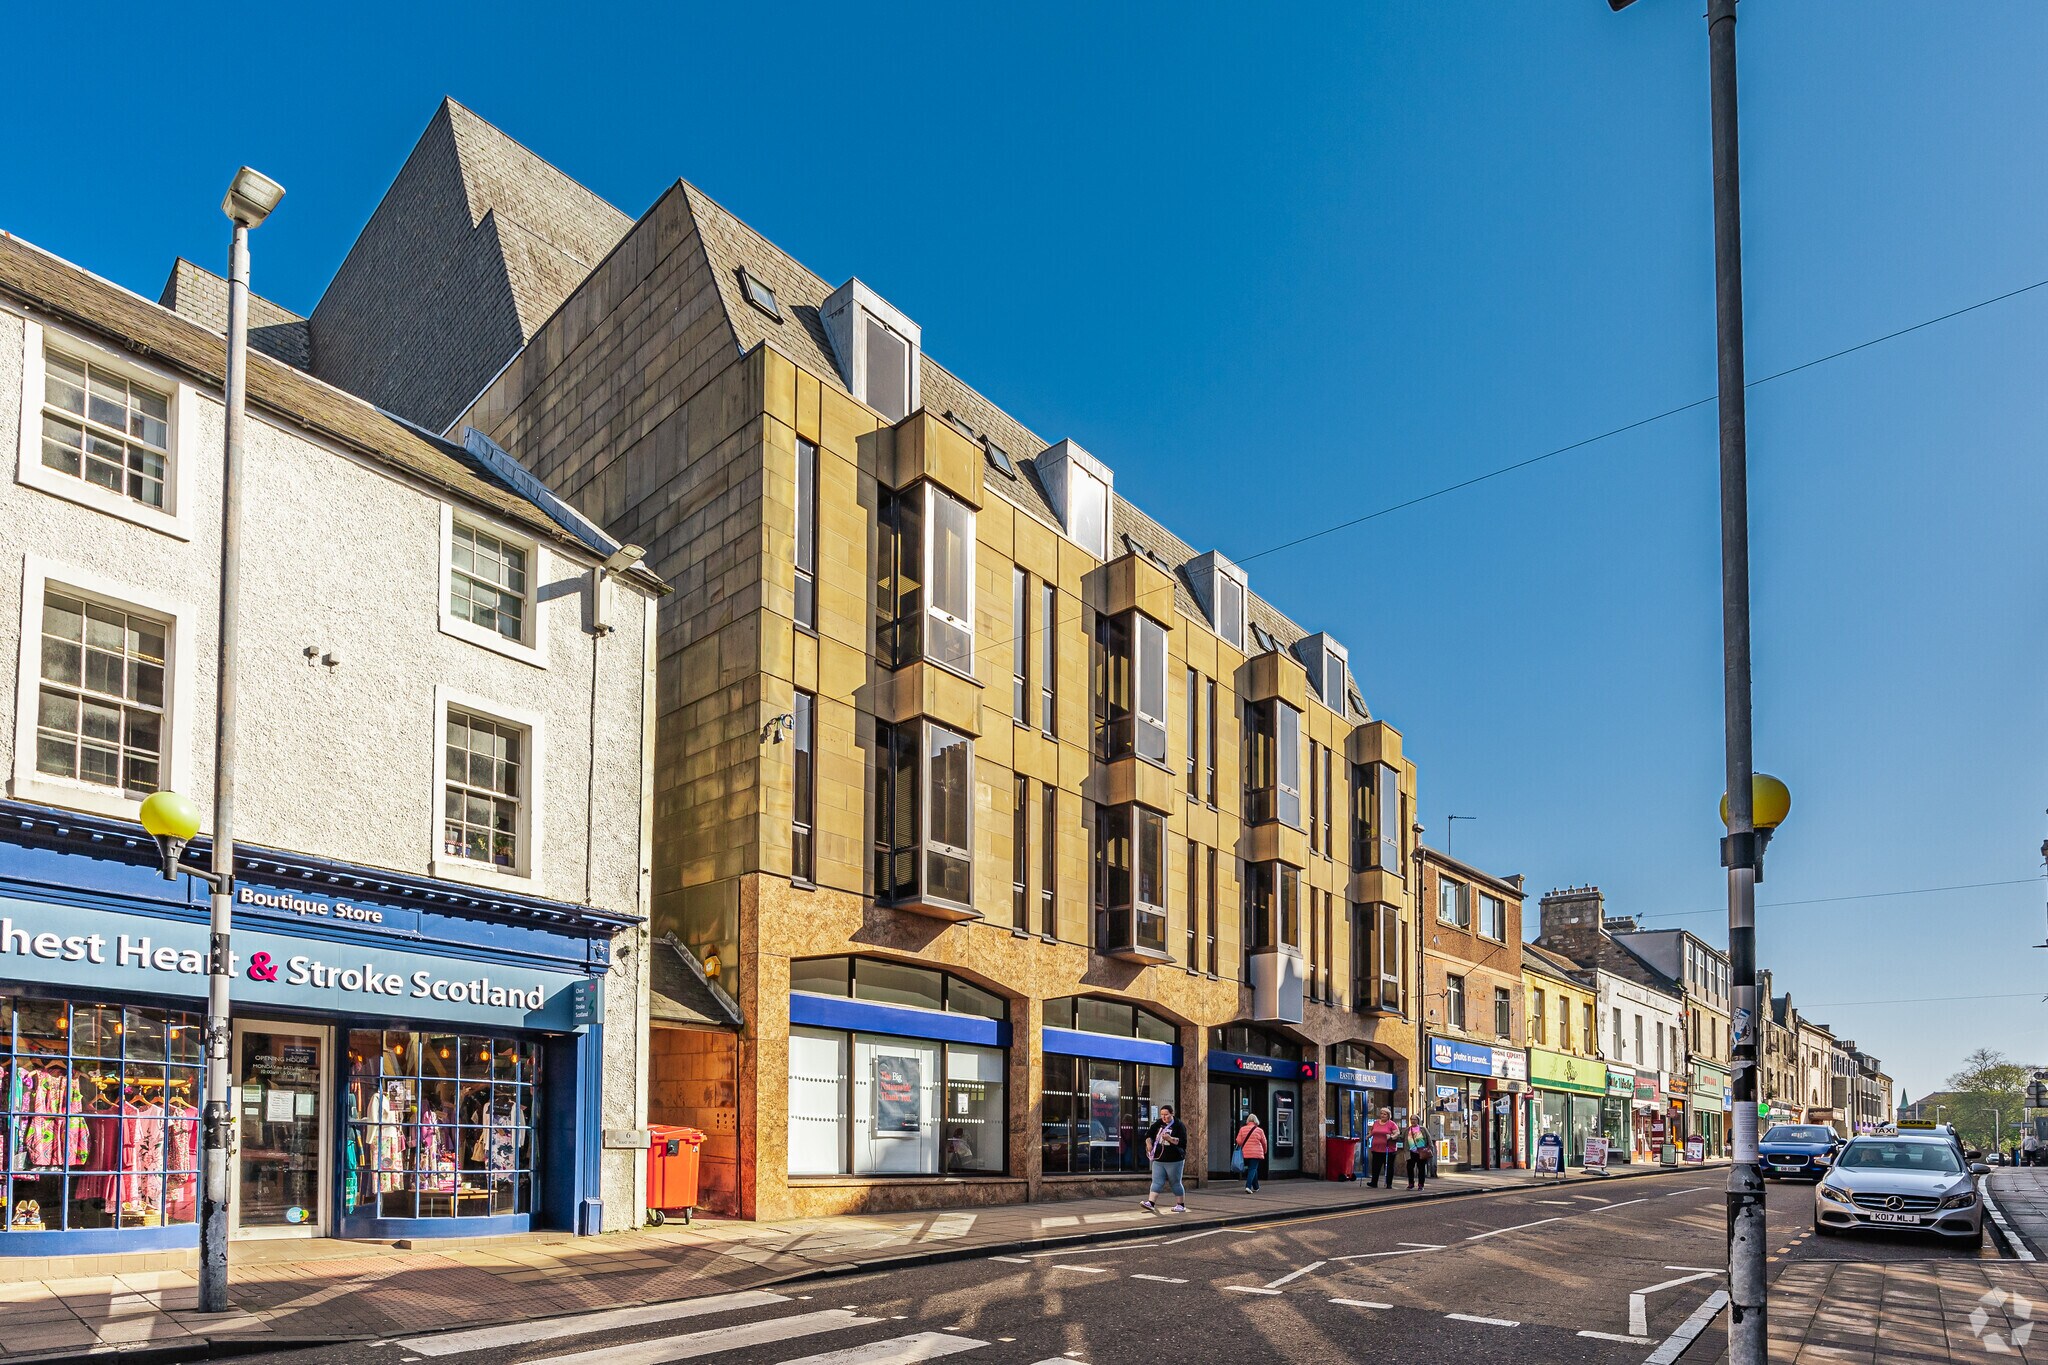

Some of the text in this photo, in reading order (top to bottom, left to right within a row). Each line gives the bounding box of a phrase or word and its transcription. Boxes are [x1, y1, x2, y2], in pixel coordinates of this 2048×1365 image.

[240, 887, 383, 923] Boutique Store
[249, 951, 279, 981] &
[288, 955, 404, 995] Stroke
[411, 970, 545, 1010] Scotland
[1435, 1044, 1452, 1057] MAX
[1453, 1051, 1467, 1062] photos
[1467, 1053, 1472, 1061] in
[254, 1055, 308, 1064] OPENING HOURS
[1242, 1061, 1273, 1073] nationwide
[892, 1071, 903, 1083] Big
[1362, 1074, 1377, 1083] HOUSE
